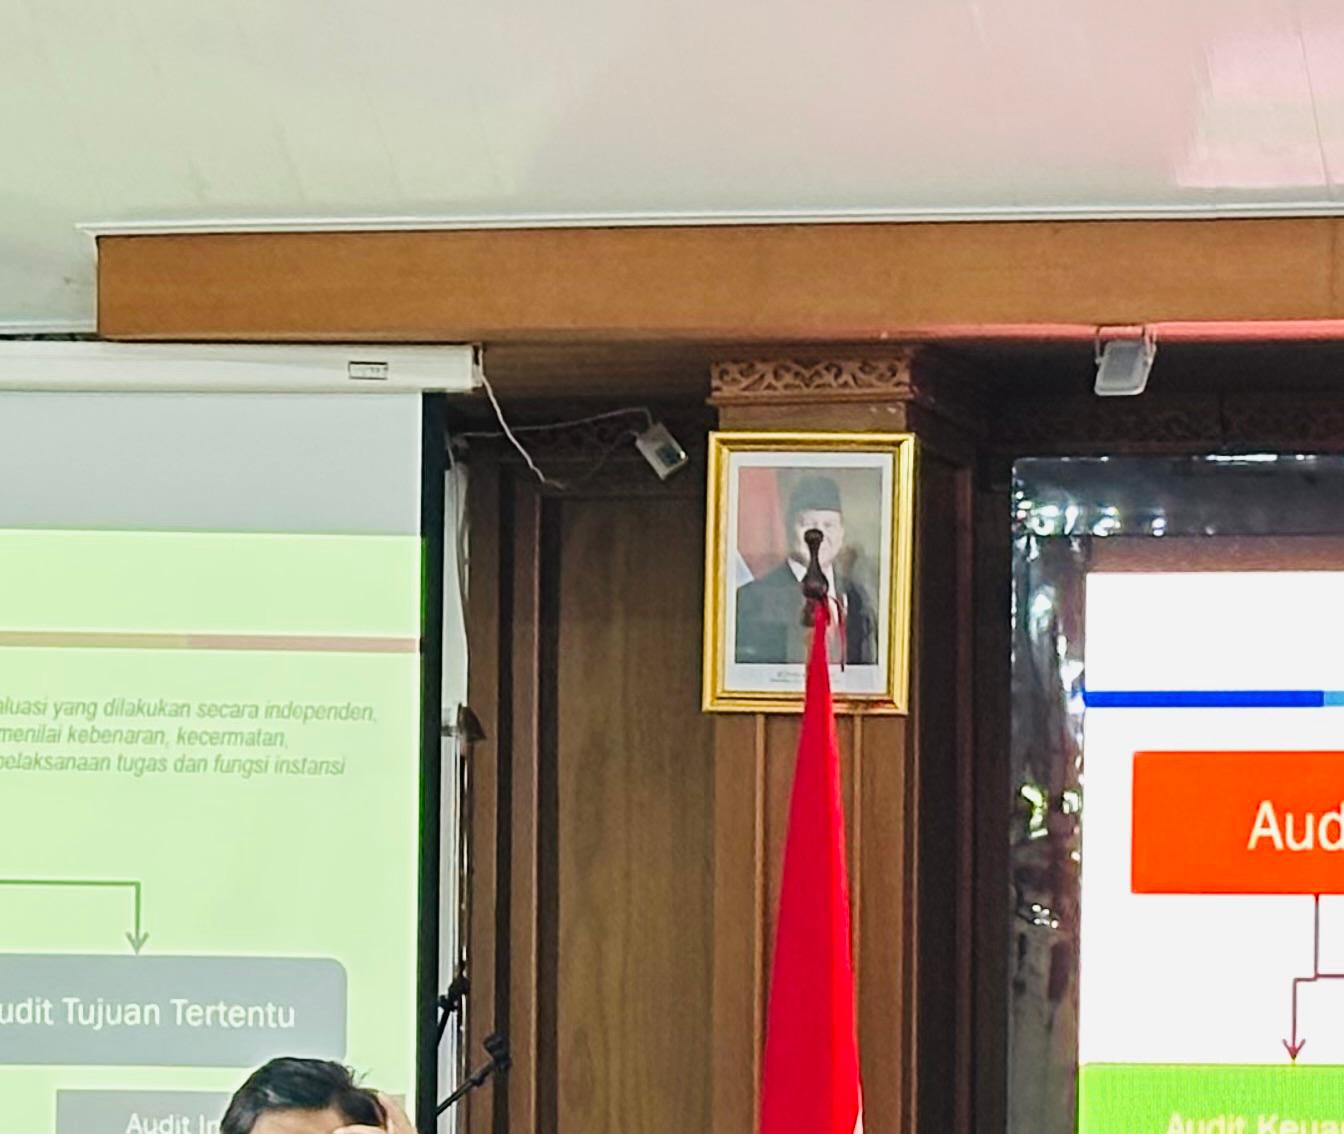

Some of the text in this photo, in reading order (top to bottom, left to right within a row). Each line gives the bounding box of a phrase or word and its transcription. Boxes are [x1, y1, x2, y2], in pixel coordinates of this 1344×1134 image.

[53, 700, 97, 721] yang
[103, 698, 191, 718] dilakukan
[196, 703, 259, 719] secara
[264, 700, 377, 724] independen,
[67, 725, 170, 749] kebenaran,
[176, 727, 288, 750] kecermatan,
[116, 755, 168, 777] tugas
[173, 753, 206, 773] dan
[212, 754, 269, 779] fungsi
[274, 756, 346, 776] instansi
[62, 997, 160, 1030] Tujuan
[170, 999, 296, 1028] Tertentu
